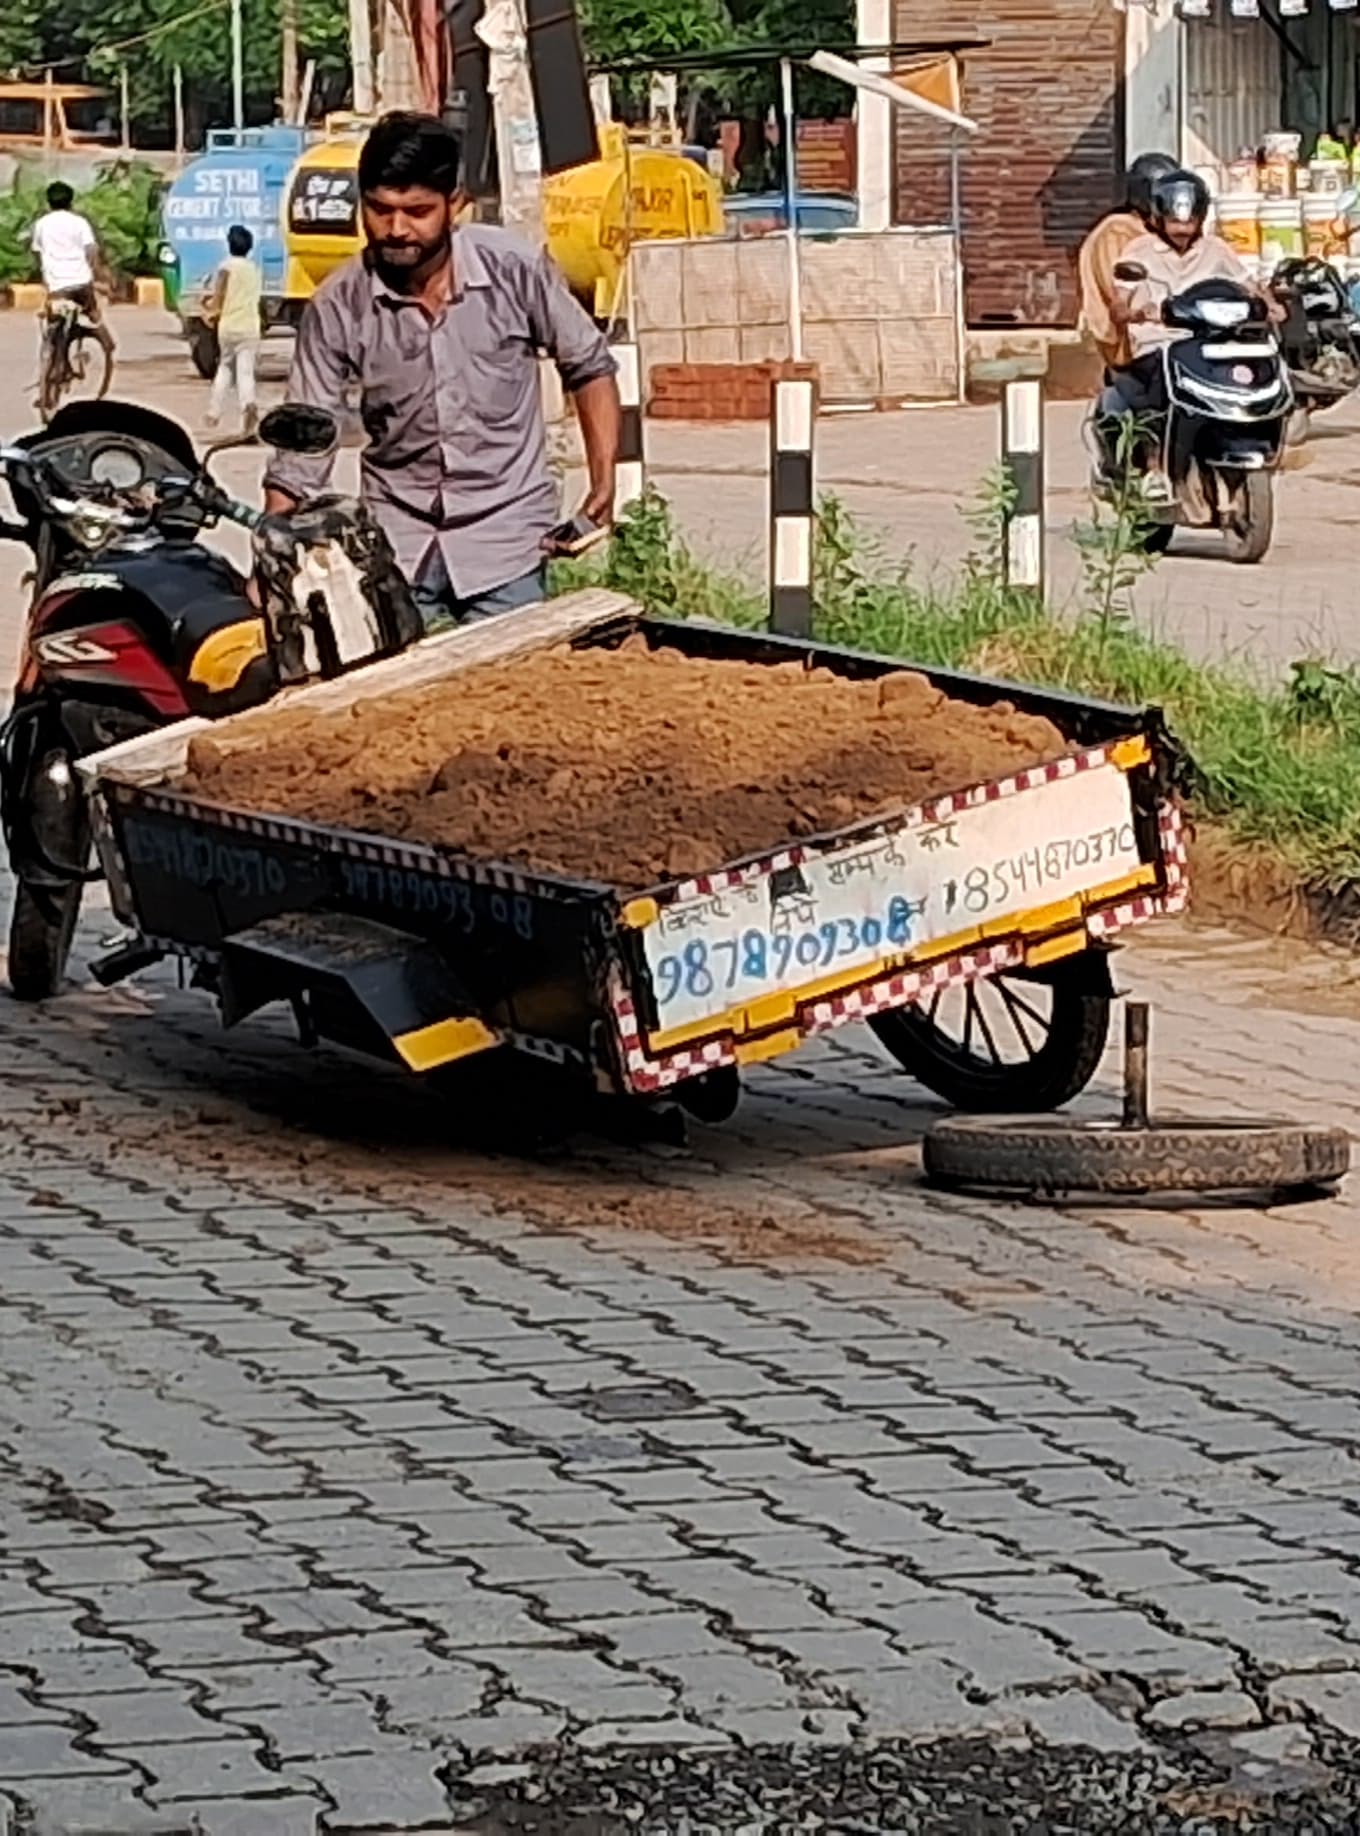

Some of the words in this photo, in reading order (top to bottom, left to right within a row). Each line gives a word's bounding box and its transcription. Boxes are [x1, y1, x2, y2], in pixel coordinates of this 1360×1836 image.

[195, 168, 259, 193] SETHI
[657, 895, 912, 1007] 9878909308
[964, 823, 1136, 913] 8544870370
